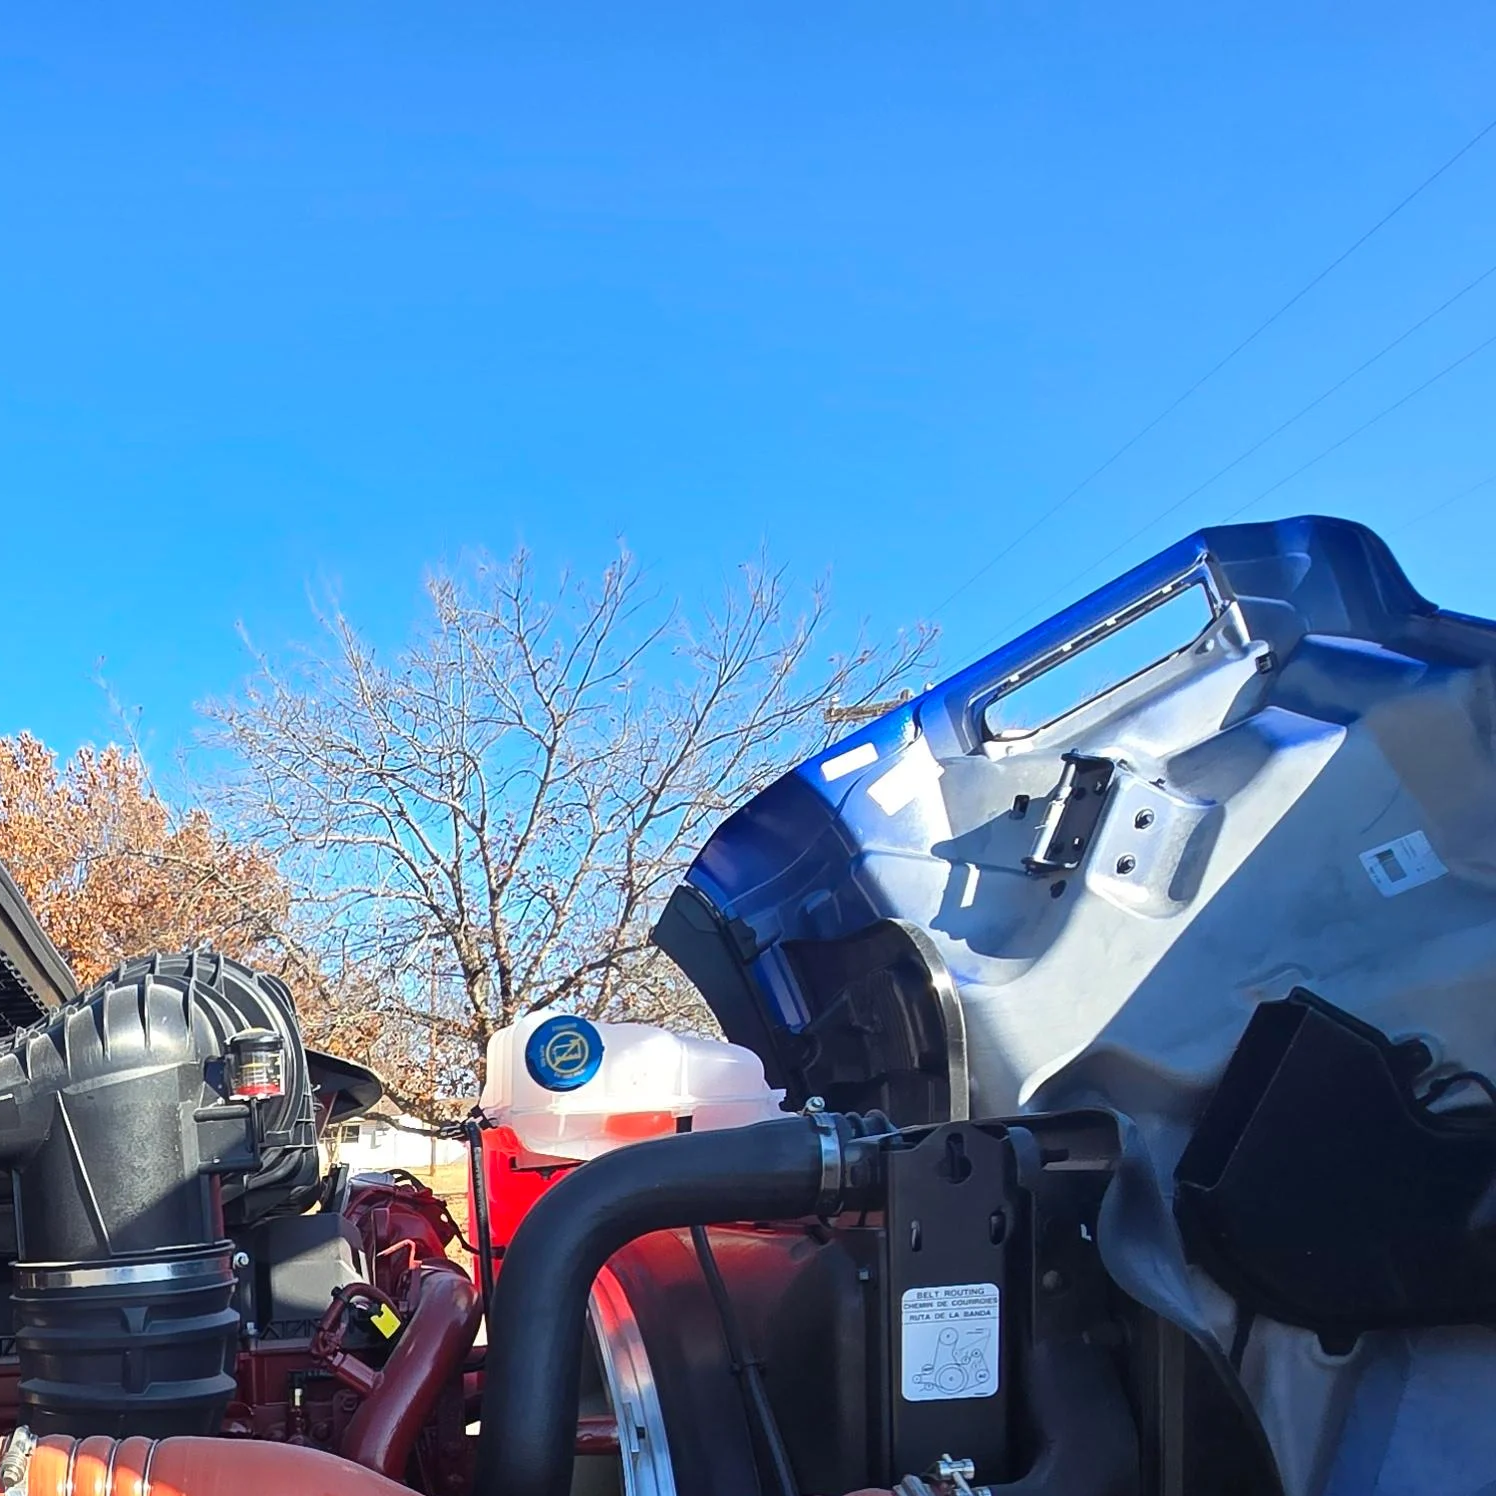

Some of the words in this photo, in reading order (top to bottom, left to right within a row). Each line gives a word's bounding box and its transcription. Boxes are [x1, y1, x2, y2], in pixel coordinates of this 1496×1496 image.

[916, 1291, 939, 1299] BELT
[944, 1287, 985, 1297] ROUTING
[904, 1302, 933, 1310] CHEMIN
[909, 1313, 931, 1321] RUTA
[949, 1311, 960, 1319] LA
[963, 1309, 992, 1317] BANDA
